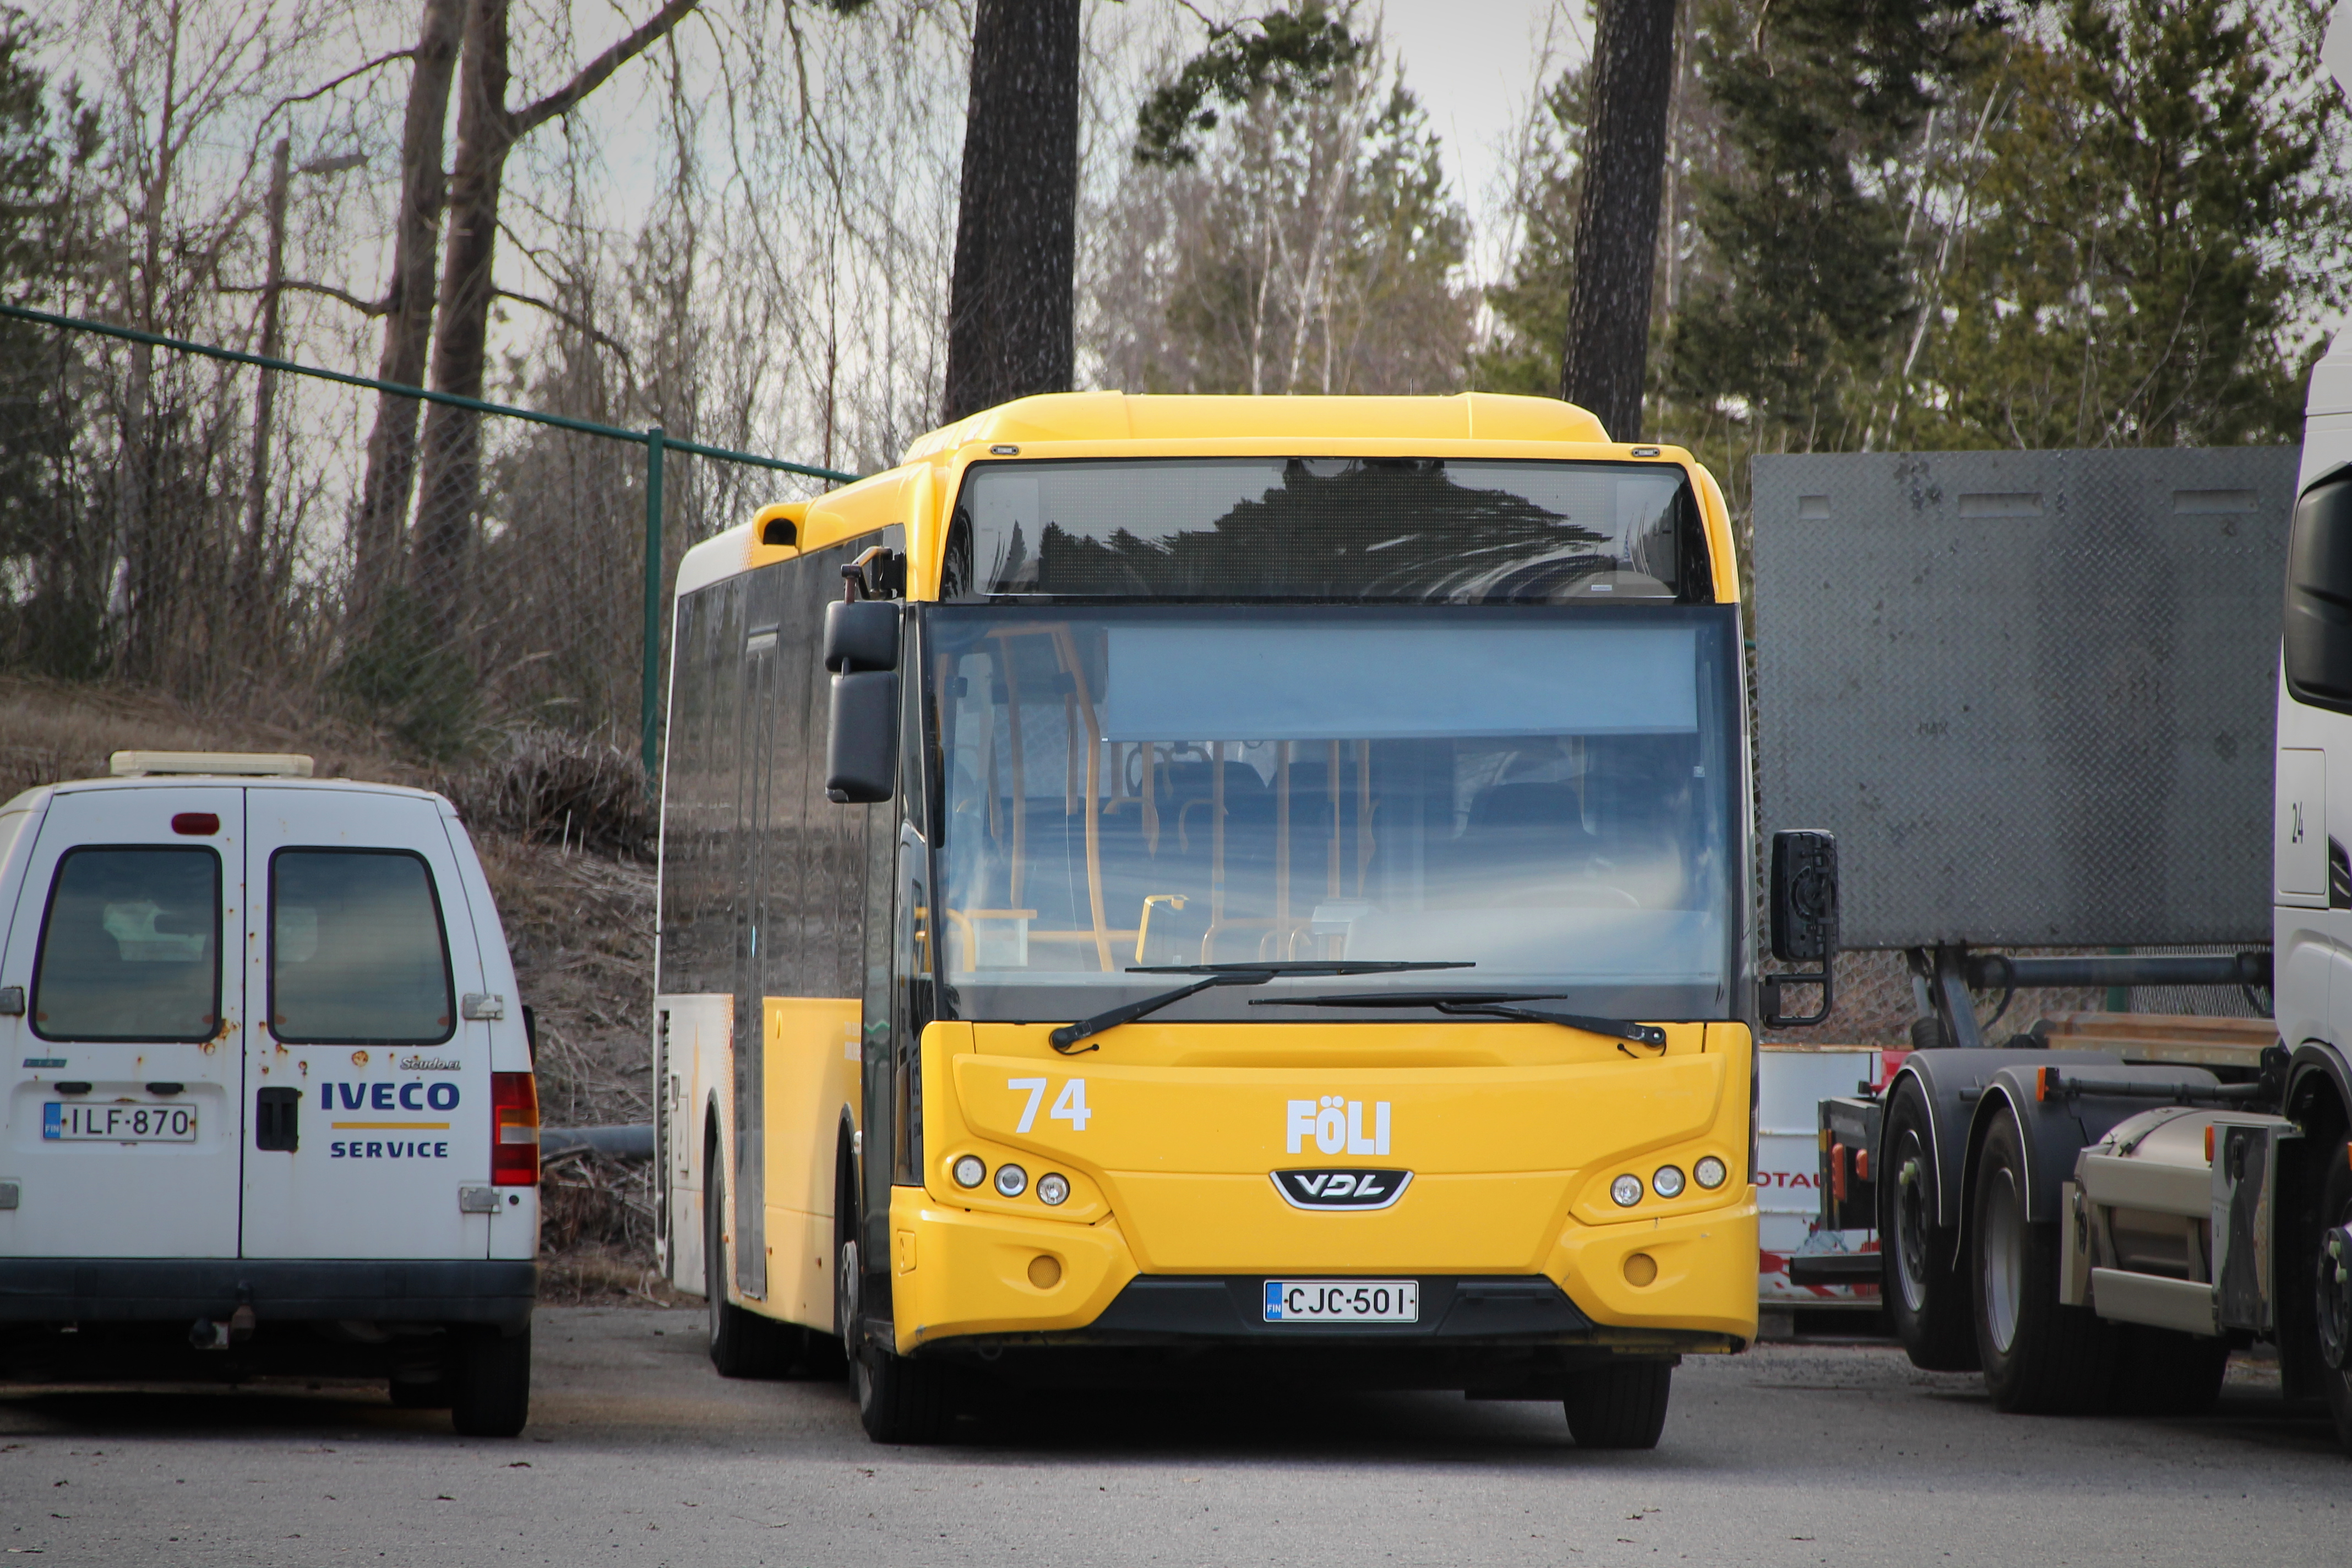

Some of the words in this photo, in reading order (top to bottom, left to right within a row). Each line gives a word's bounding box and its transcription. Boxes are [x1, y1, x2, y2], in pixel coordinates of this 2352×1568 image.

[2292, 801, 2304, 844] 24
[400, 1058, 447, 1070] Scudo
[322, 1082, 460, 1110] IVECO
[1008, 1077, 1091, 1133] 74
[73, 1109, 188, 1135] ILF-870
[1287, 1096, 1391, 1155] FÖLI
[331, 1142, 448, 1158] SERVICE
[1294, 1174, 1385, 1197] VDL
[1267, 1304, 1281, 1314] FIN
[1288, 1288, 1403, 1315] CJC-501
